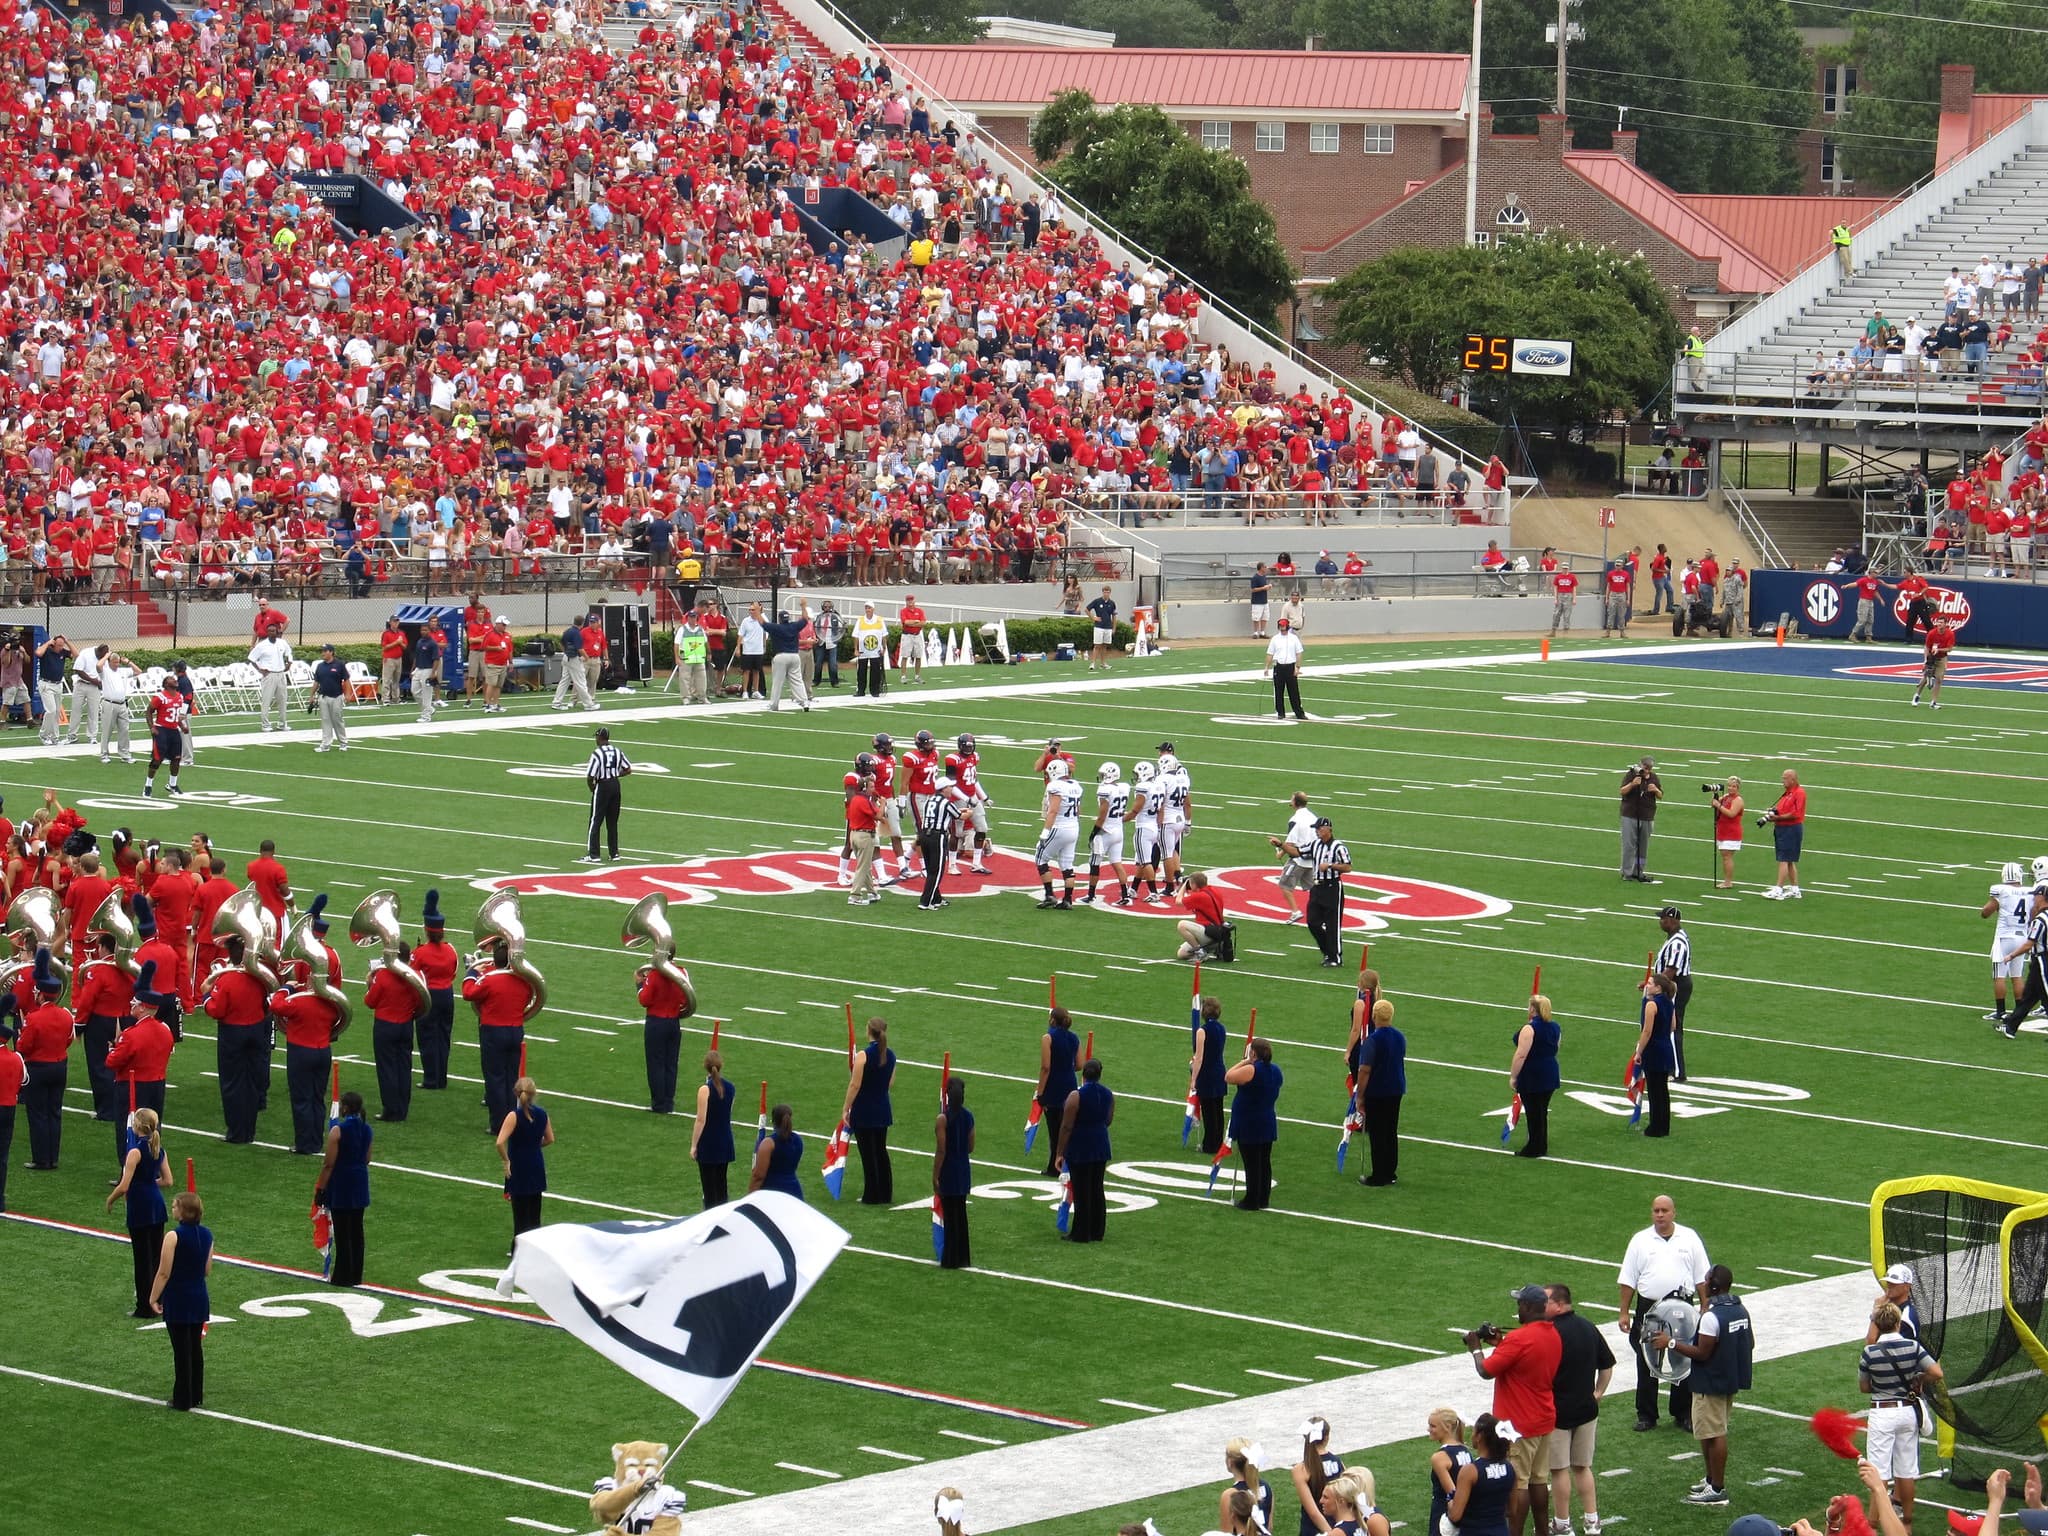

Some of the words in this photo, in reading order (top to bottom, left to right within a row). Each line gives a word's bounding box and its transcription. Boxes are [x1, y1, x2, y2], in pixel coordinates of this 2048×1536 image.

[1465, 337, 1508, 370] 25
[1525, 350, 1558, 365] Ford
[1607, 510, 1615, 524] A
[1806, 583, 1839, 623] SEC
[864, 636, 878, 650] SEC
[605, 751, 615, 767] F
[884, 767, 894, 786] 7
[925, 801, 937, 817] R
[2014, 898, 2026, 924] 4
[1322, 1459, 1340, 1477] YU
[1485, 1462, 1508, 1480] BYU
